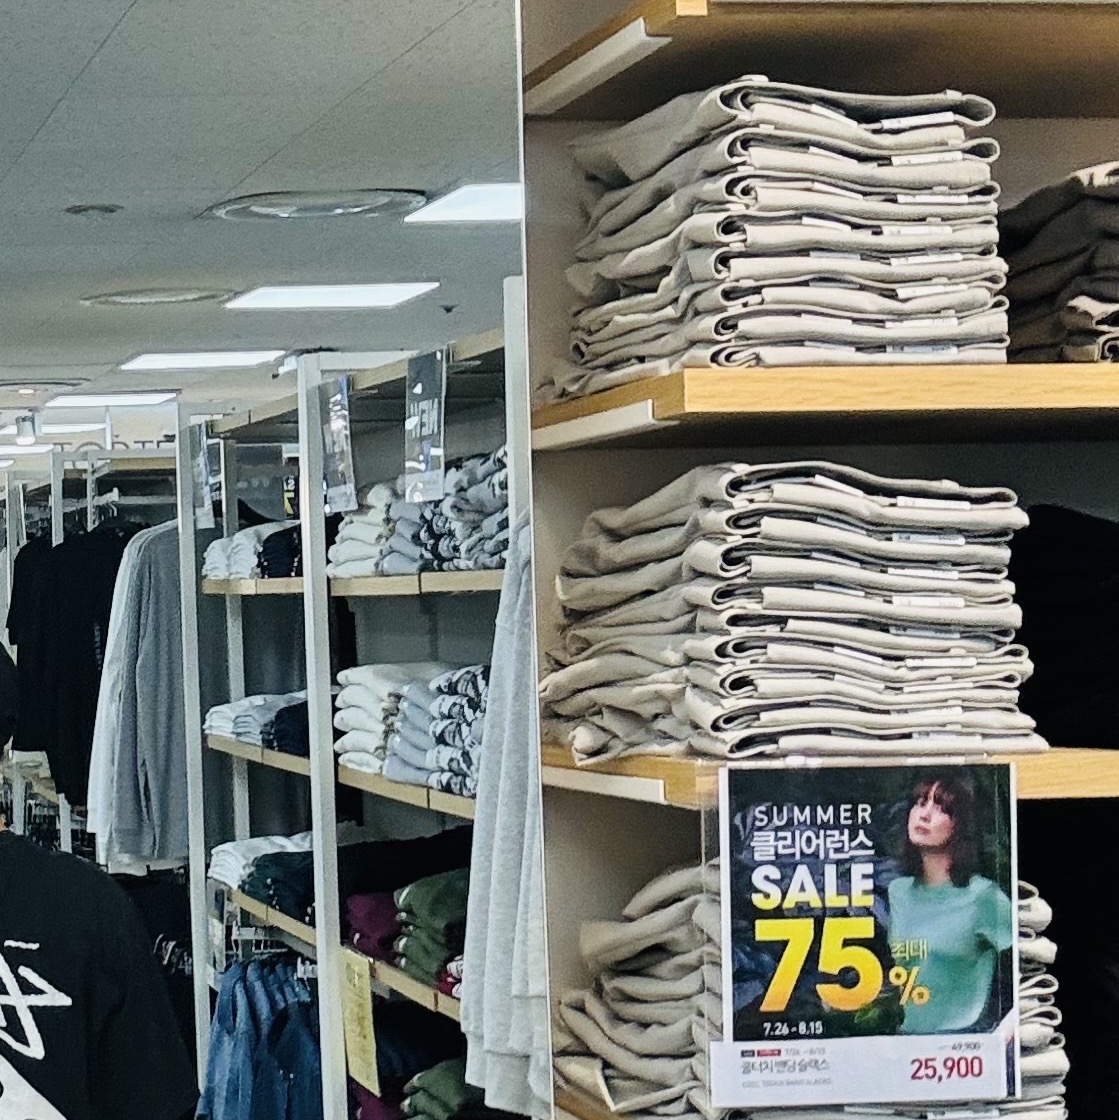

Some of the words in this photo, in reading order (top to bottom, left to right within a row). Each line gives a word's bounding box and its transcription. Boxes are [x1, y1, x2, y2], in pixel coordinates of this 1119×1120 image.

[754, 803, 872, 827] SUMMER
[750, 828, 875, 861] 클리어런스
[750, 862, 875, 911] SALE
[891, 937, 928, 961] 최대
[910, 1056, 984, 1083] 25,900
